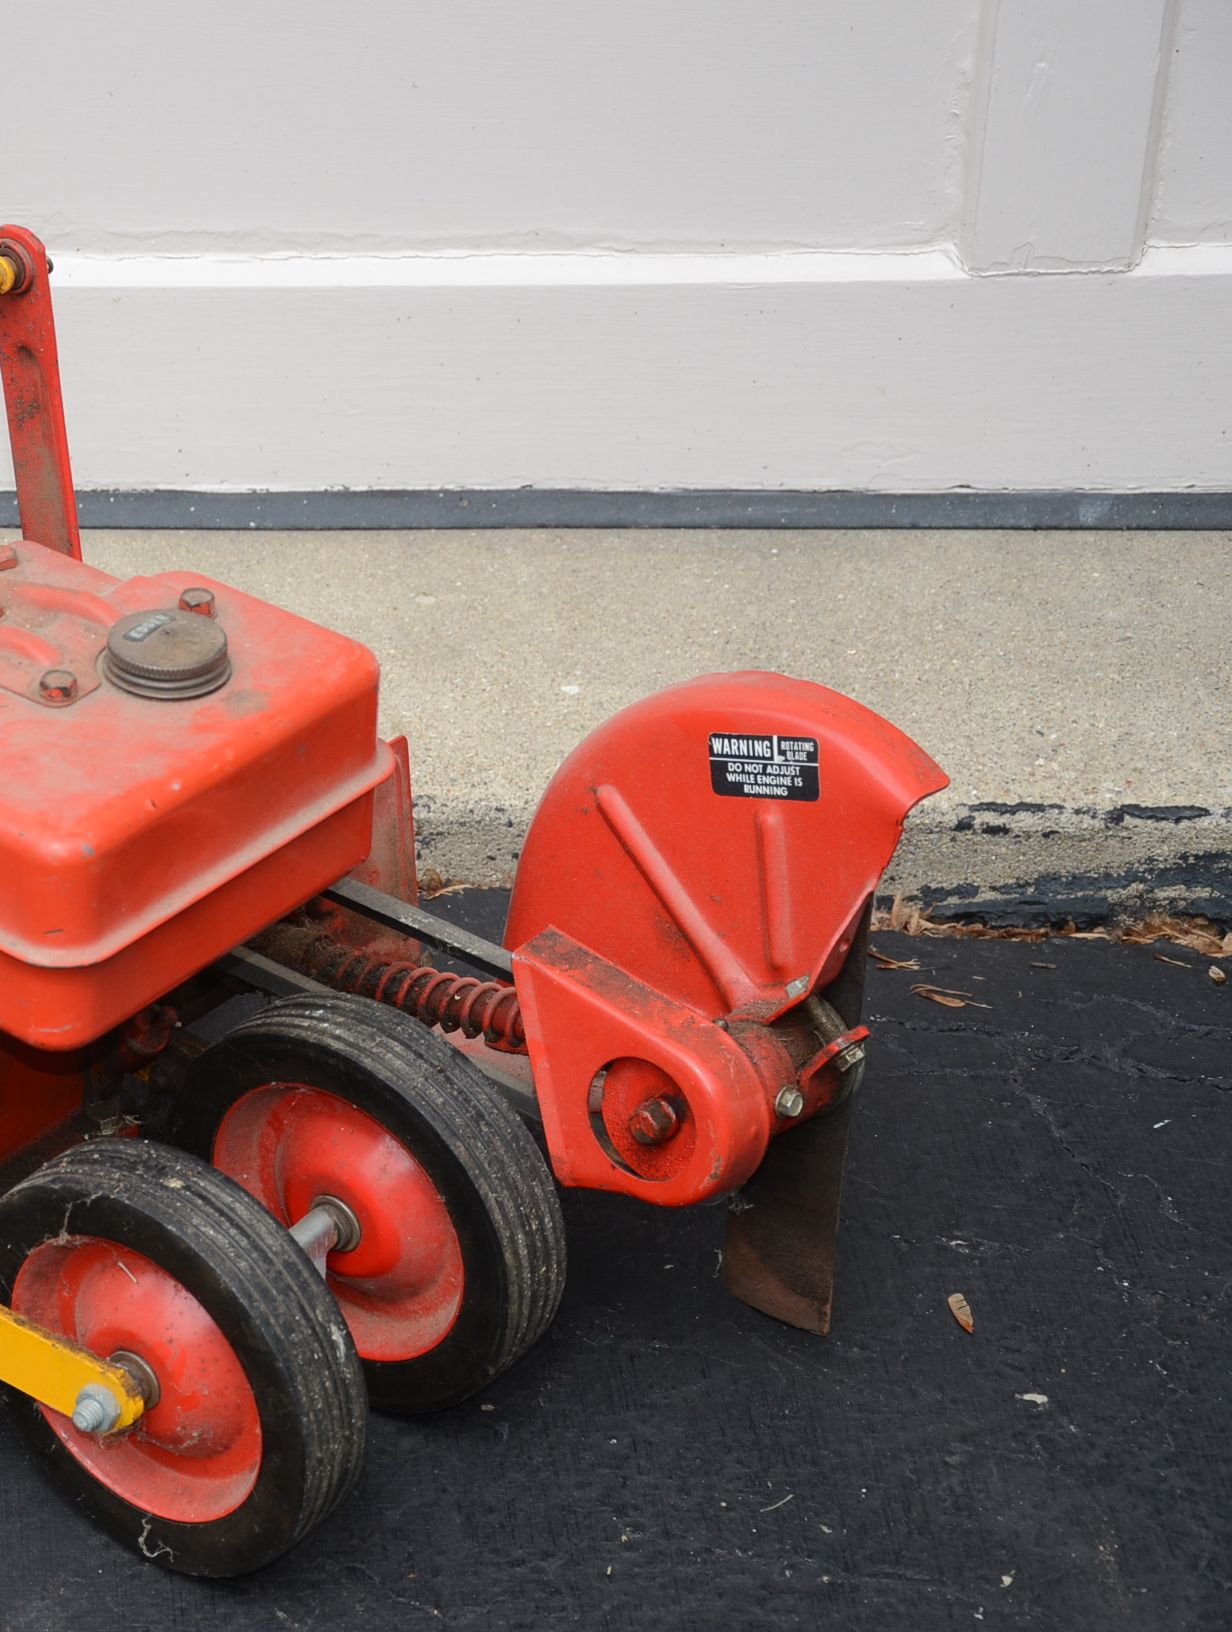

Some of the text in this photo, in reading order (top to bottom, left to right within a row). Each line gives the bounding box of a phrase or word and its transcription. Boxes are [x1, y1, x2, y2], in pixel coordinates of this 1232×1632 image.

[712, 737, 771, 757] WARNING
[781, 741, 814, 751] ROTATING
[787, 752, 807, 761] BLADE
[728, 763, 800, 775] DO NOT ADJUST
[726, 773, 803, 786] WHILE ENGINE IS
[744, 785, 788, 796] RUNNING
